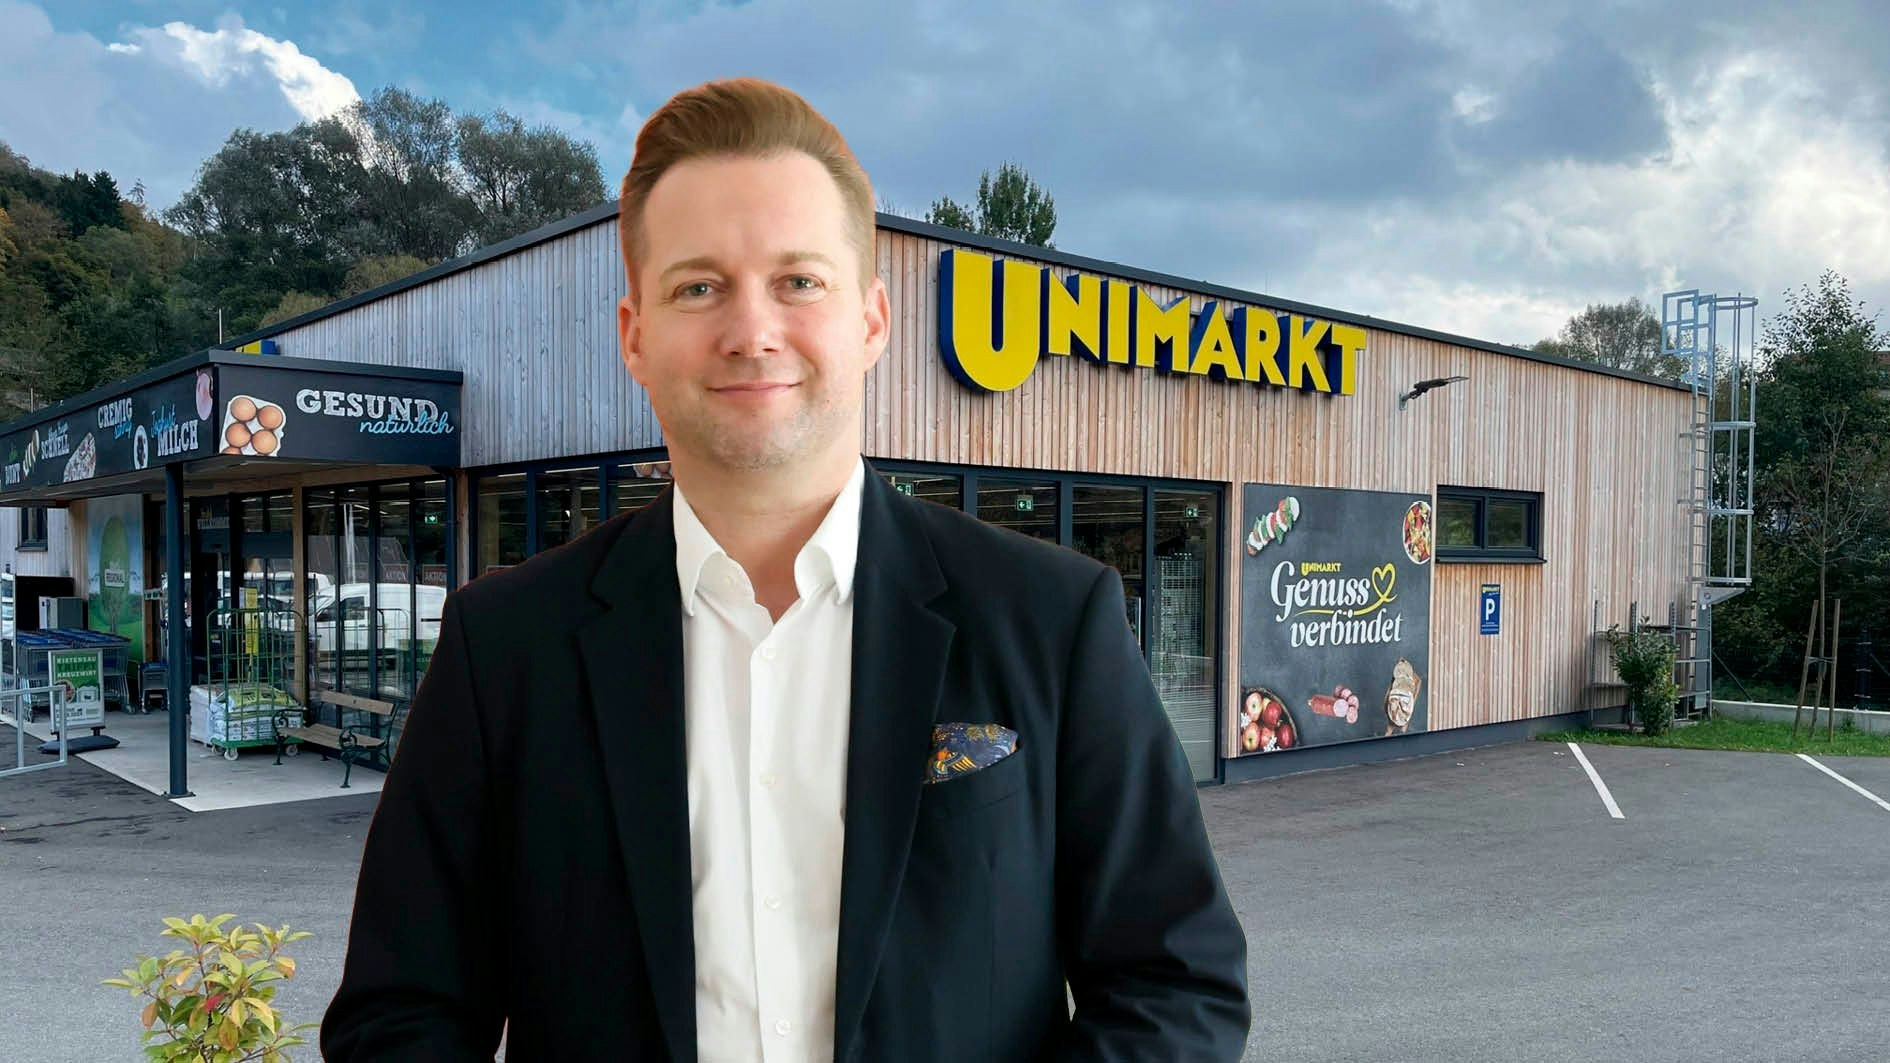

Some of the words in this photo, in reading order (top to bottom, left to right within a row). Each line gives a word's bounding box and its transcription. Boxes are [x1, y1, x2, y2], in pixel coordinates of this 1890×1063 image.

[941, 249, 1366, 396] UNIMARKT
[98, 398, 132, 428] CREMIG
[296, 389, 438, 421] GESUND
[158, 419, 198, 456] MILCH
[1301, 562, 1341, 576] UNIMARKT
[1271, 560, 1370, 622] Genuss
[1486, 598, 1496, 621] P
[1290, 608, 1403, 647] verbindet
